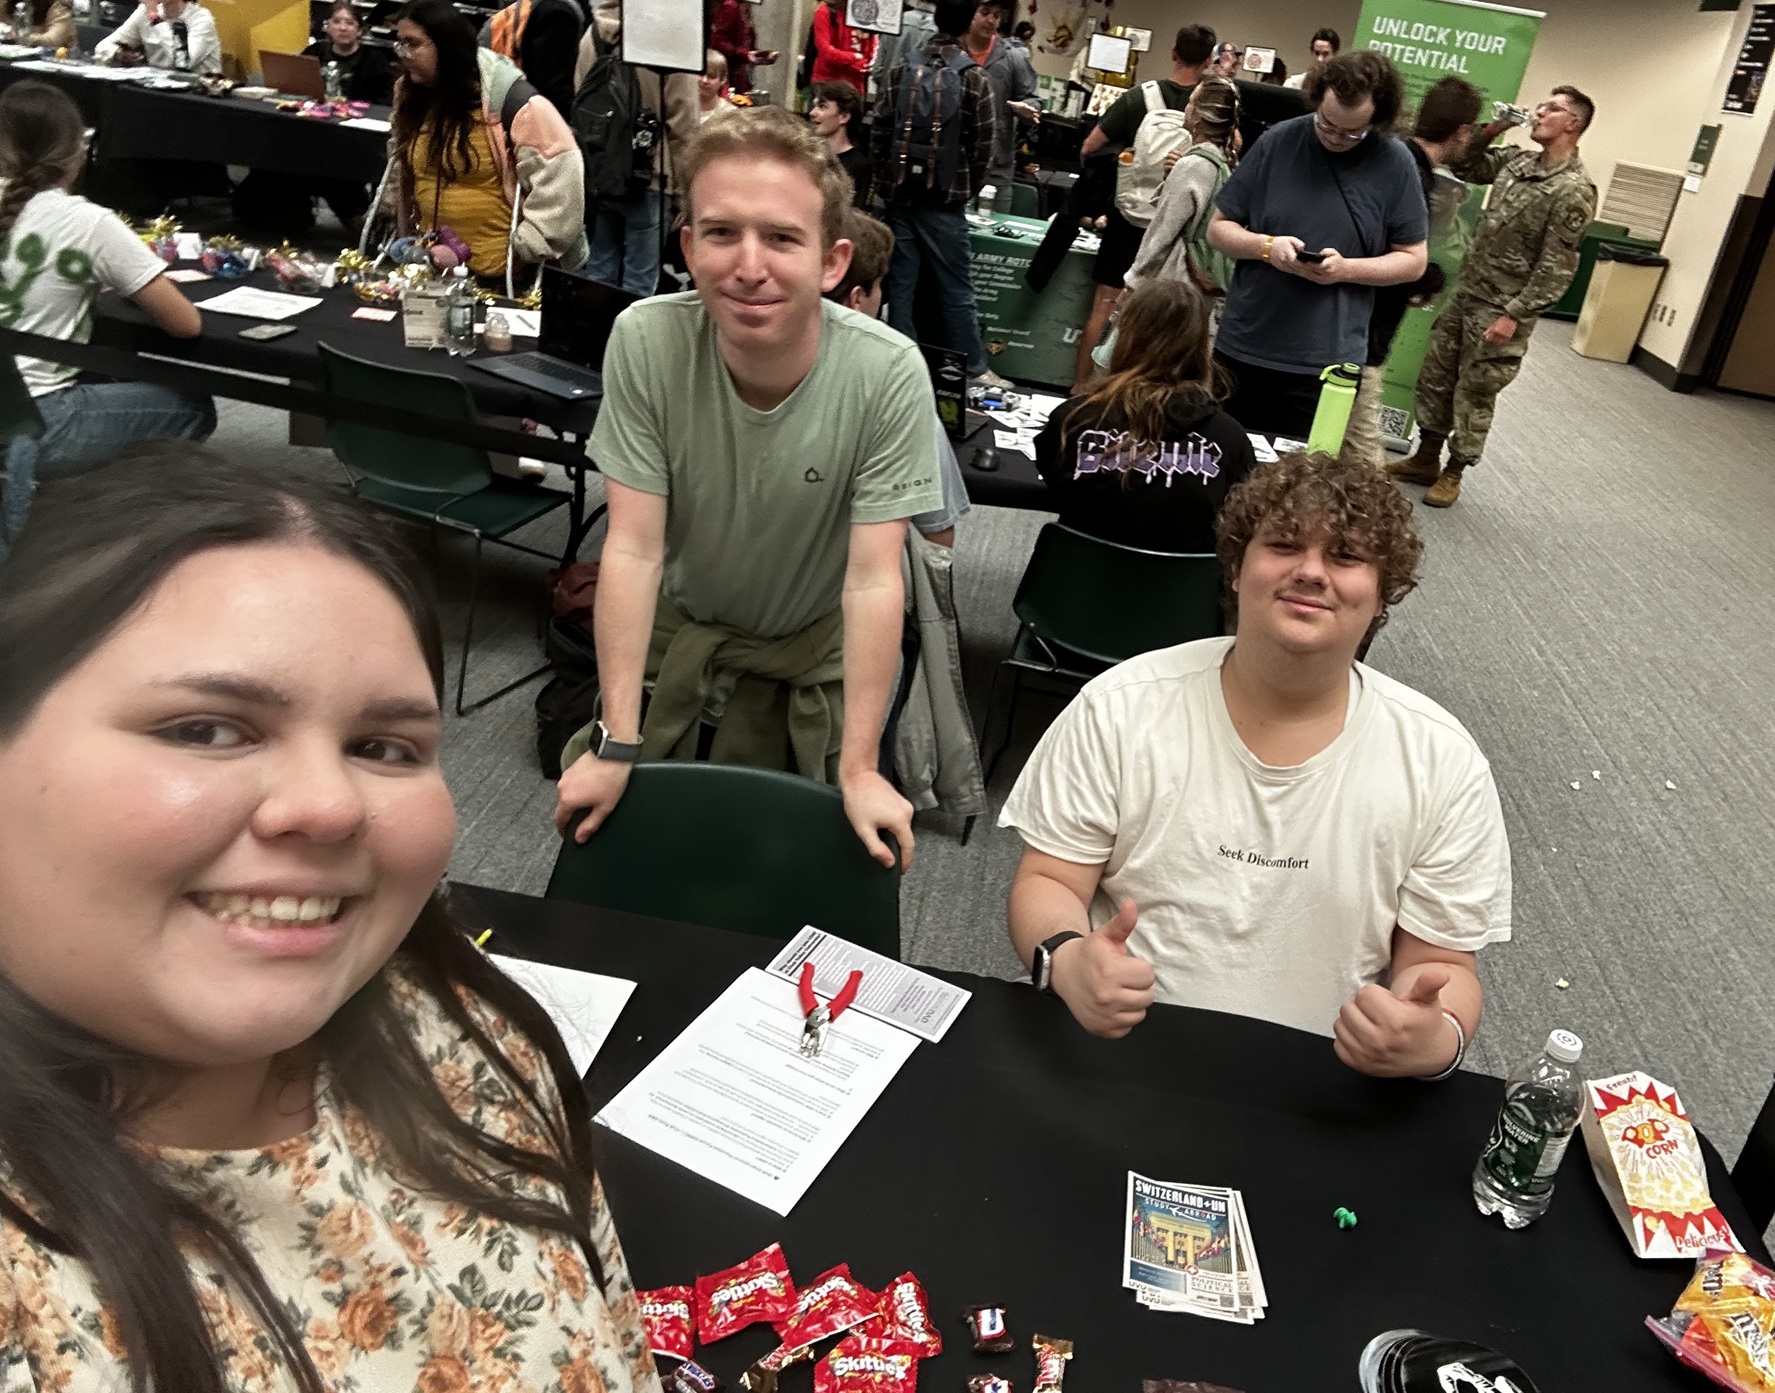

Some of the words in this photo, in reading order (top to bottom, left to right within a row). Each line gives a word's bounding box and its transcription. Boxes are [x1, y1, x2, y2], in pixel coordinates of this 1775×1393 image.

[1372, 16, 1451, 46] UNLOCK
[1455, 29, 1507, 55] YOUR
[1369, 39, 1469, 74] POTENTIAL
[976, 253, 1006, 263] ARMY
[1006, 256, 1033, 267] ROTC
[1217, 844, 1244, 861] Seek
[1246, 852, 1309, 869] Discomfort
[1606, 1074, 1637, 1091] Fresh!
[1621, 1118, 1670, 1148] POP
[1645, 1139, 1679, 1159] CORN
[1144, 1197, 1170, 1210] STUDY
[1184, 1208, 1217, 1221] ABROAD
[1675, 1225, 1731, 1249] Delicious!
[711, 1271, 778, 1305] Skittles
[1129, 1280, 1146, 1290] UVU
[1142, 1295, 1160, 1304] UVU
[896, 1281, 928, 1343] Skittles
[833, 1355, 906, 1380] Skittles
